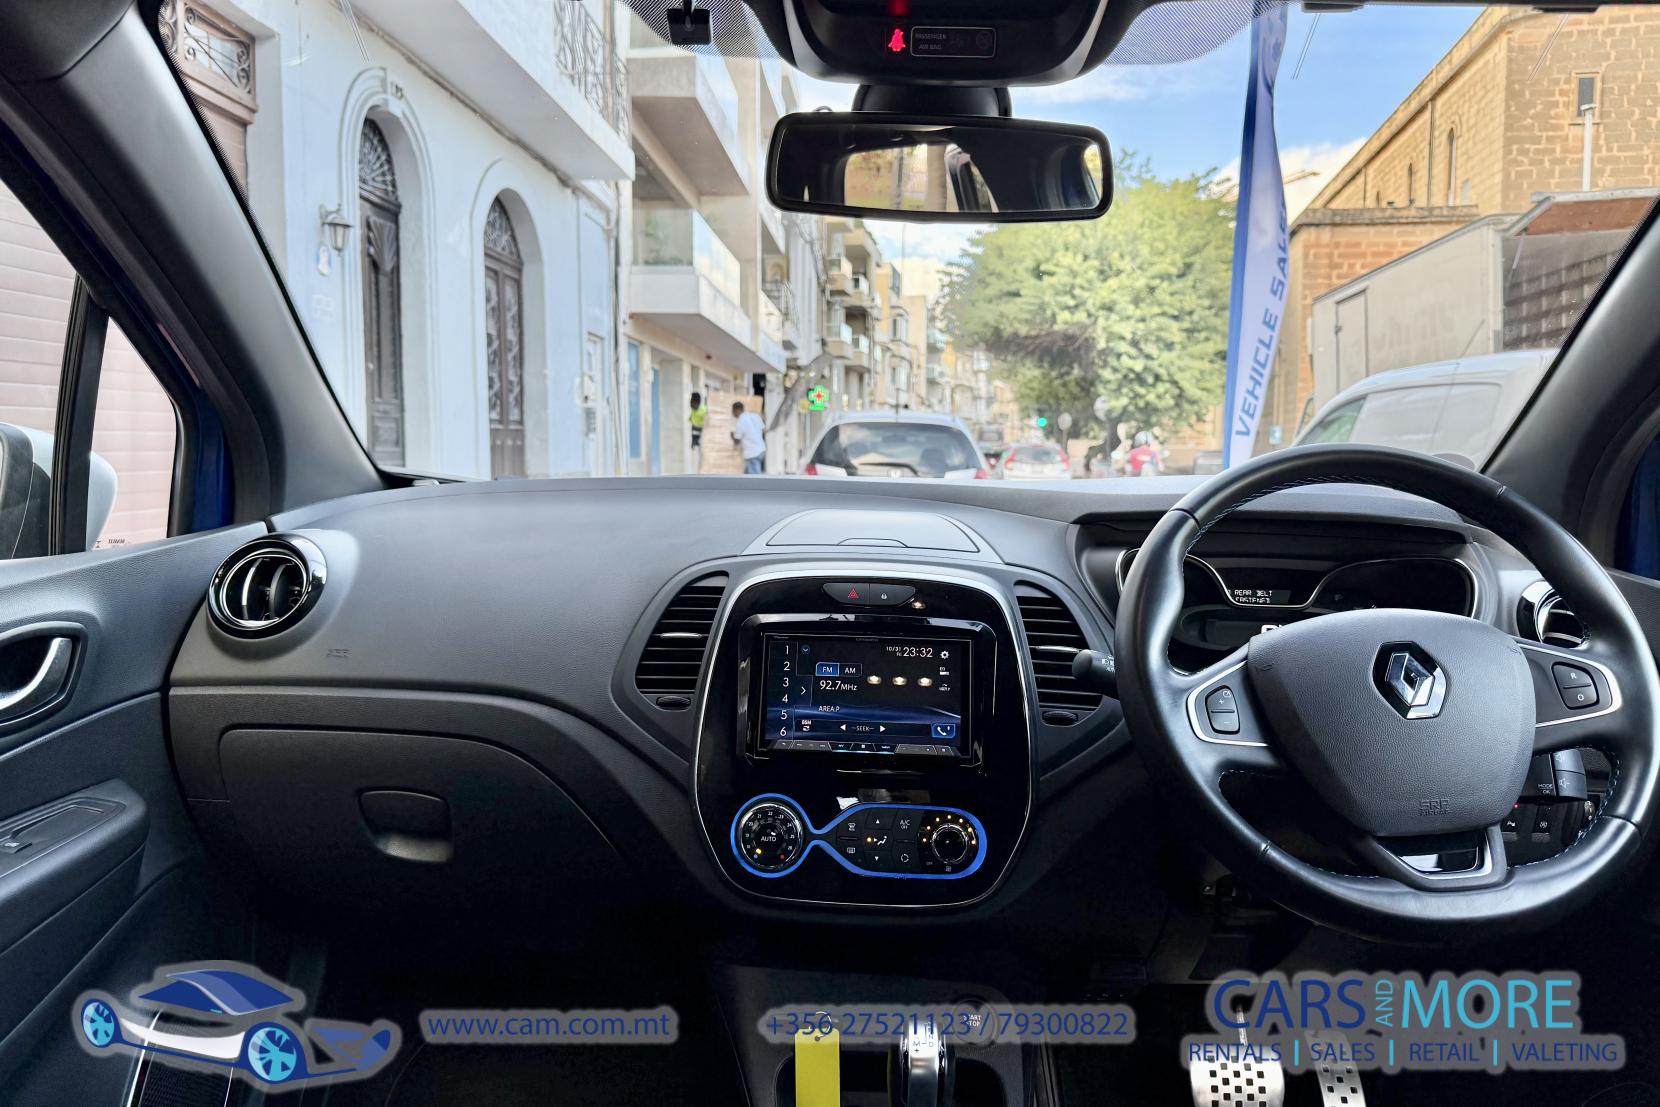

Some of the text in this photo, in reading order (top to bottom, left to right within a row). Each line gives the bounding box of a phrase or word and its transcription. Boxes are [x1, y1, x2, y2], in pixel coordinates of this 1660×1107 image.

[1235, 308, 1279, 437] VEHICLE
[785, 645, 789, 655] 1
[903, 646, 933, 658] 23:32
[783, 661, 791, 671] 2
[782, 677, 790, 687] 3
[820, 680, 858, 691] 92.7MHz
[782, 693, 789, 703] 4
[780, 709, 788, 720] 5
[780, 726, 787, 737] 6
